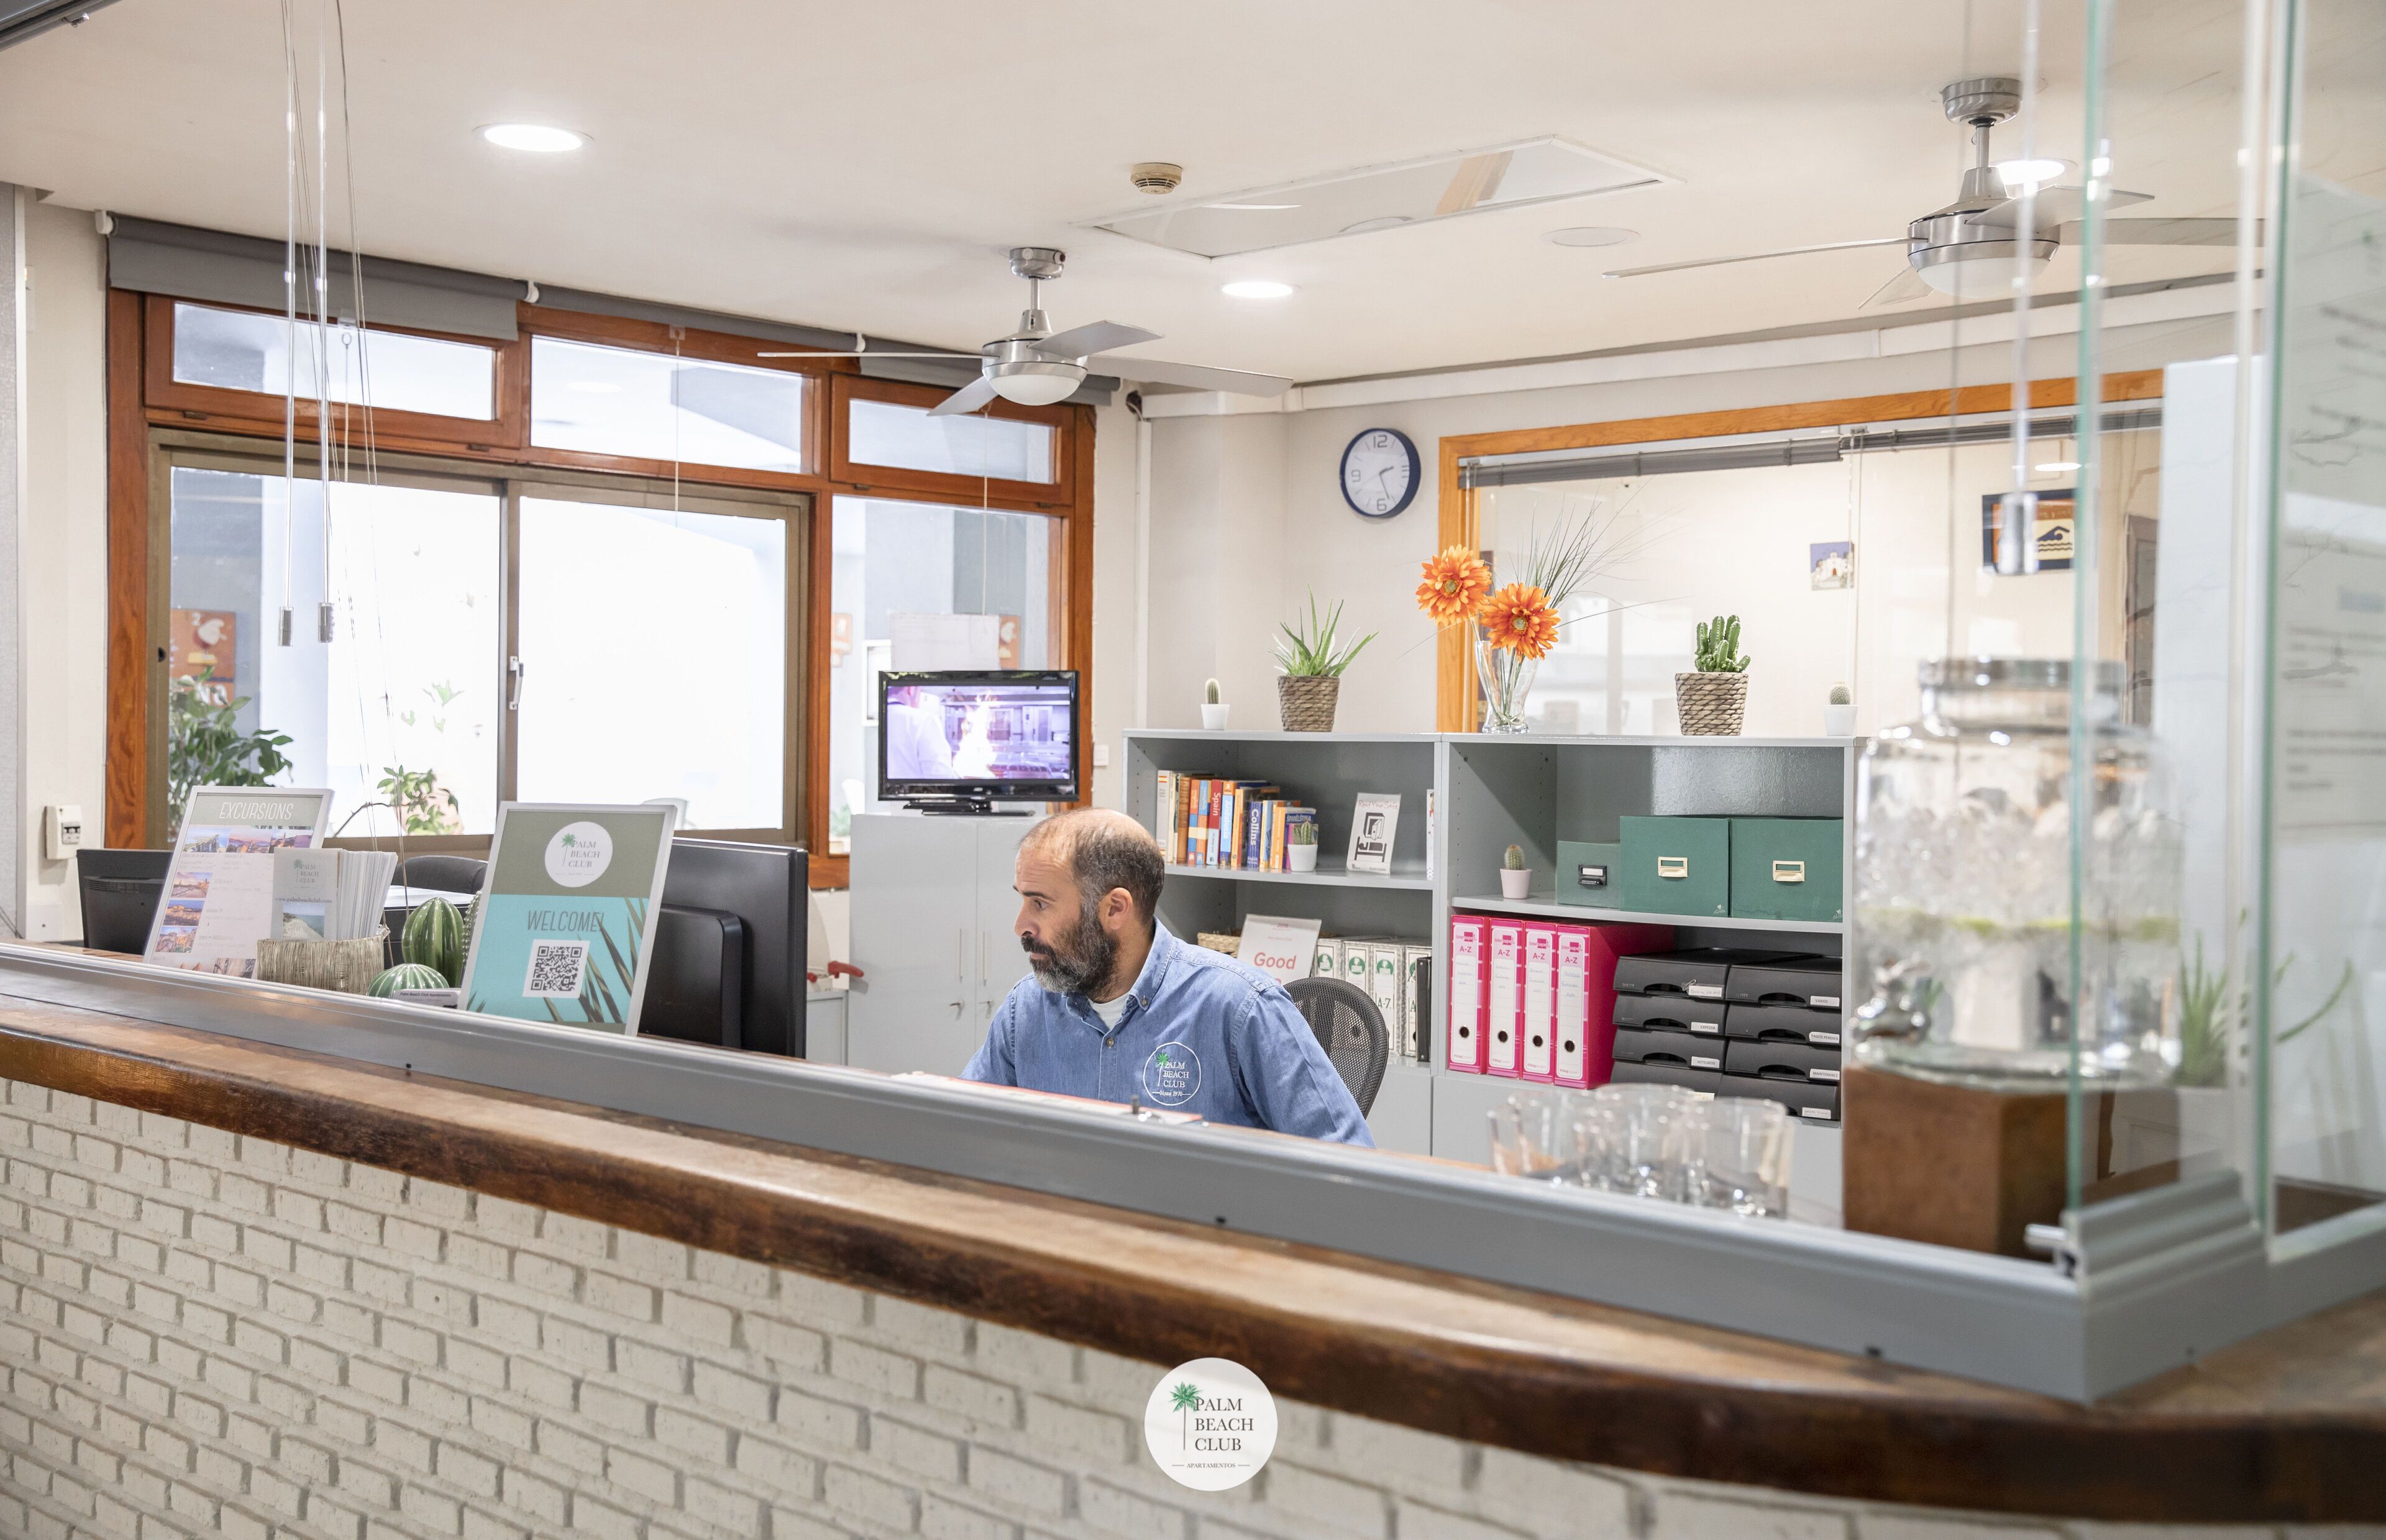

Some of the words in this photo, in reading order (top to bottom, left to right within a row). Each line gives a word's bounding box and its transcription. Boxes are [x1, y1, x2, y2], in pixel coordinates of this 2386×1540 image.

[1373, 435, 1387, 448] 12
[1351, 469, 1361, 483] 9
[1377, 499, 1387, 511] 6
[219, 802, 294, 819] EXCURSIONS
[1213, 792, 1221, 816] Spain
[1250, 809, 1259, 845] Collins
[1254, 952, 1297, 970] Good
[1165, 1062, 1186, 1070] PALM
[1163, 1070, 1189, 1078] BEACH
